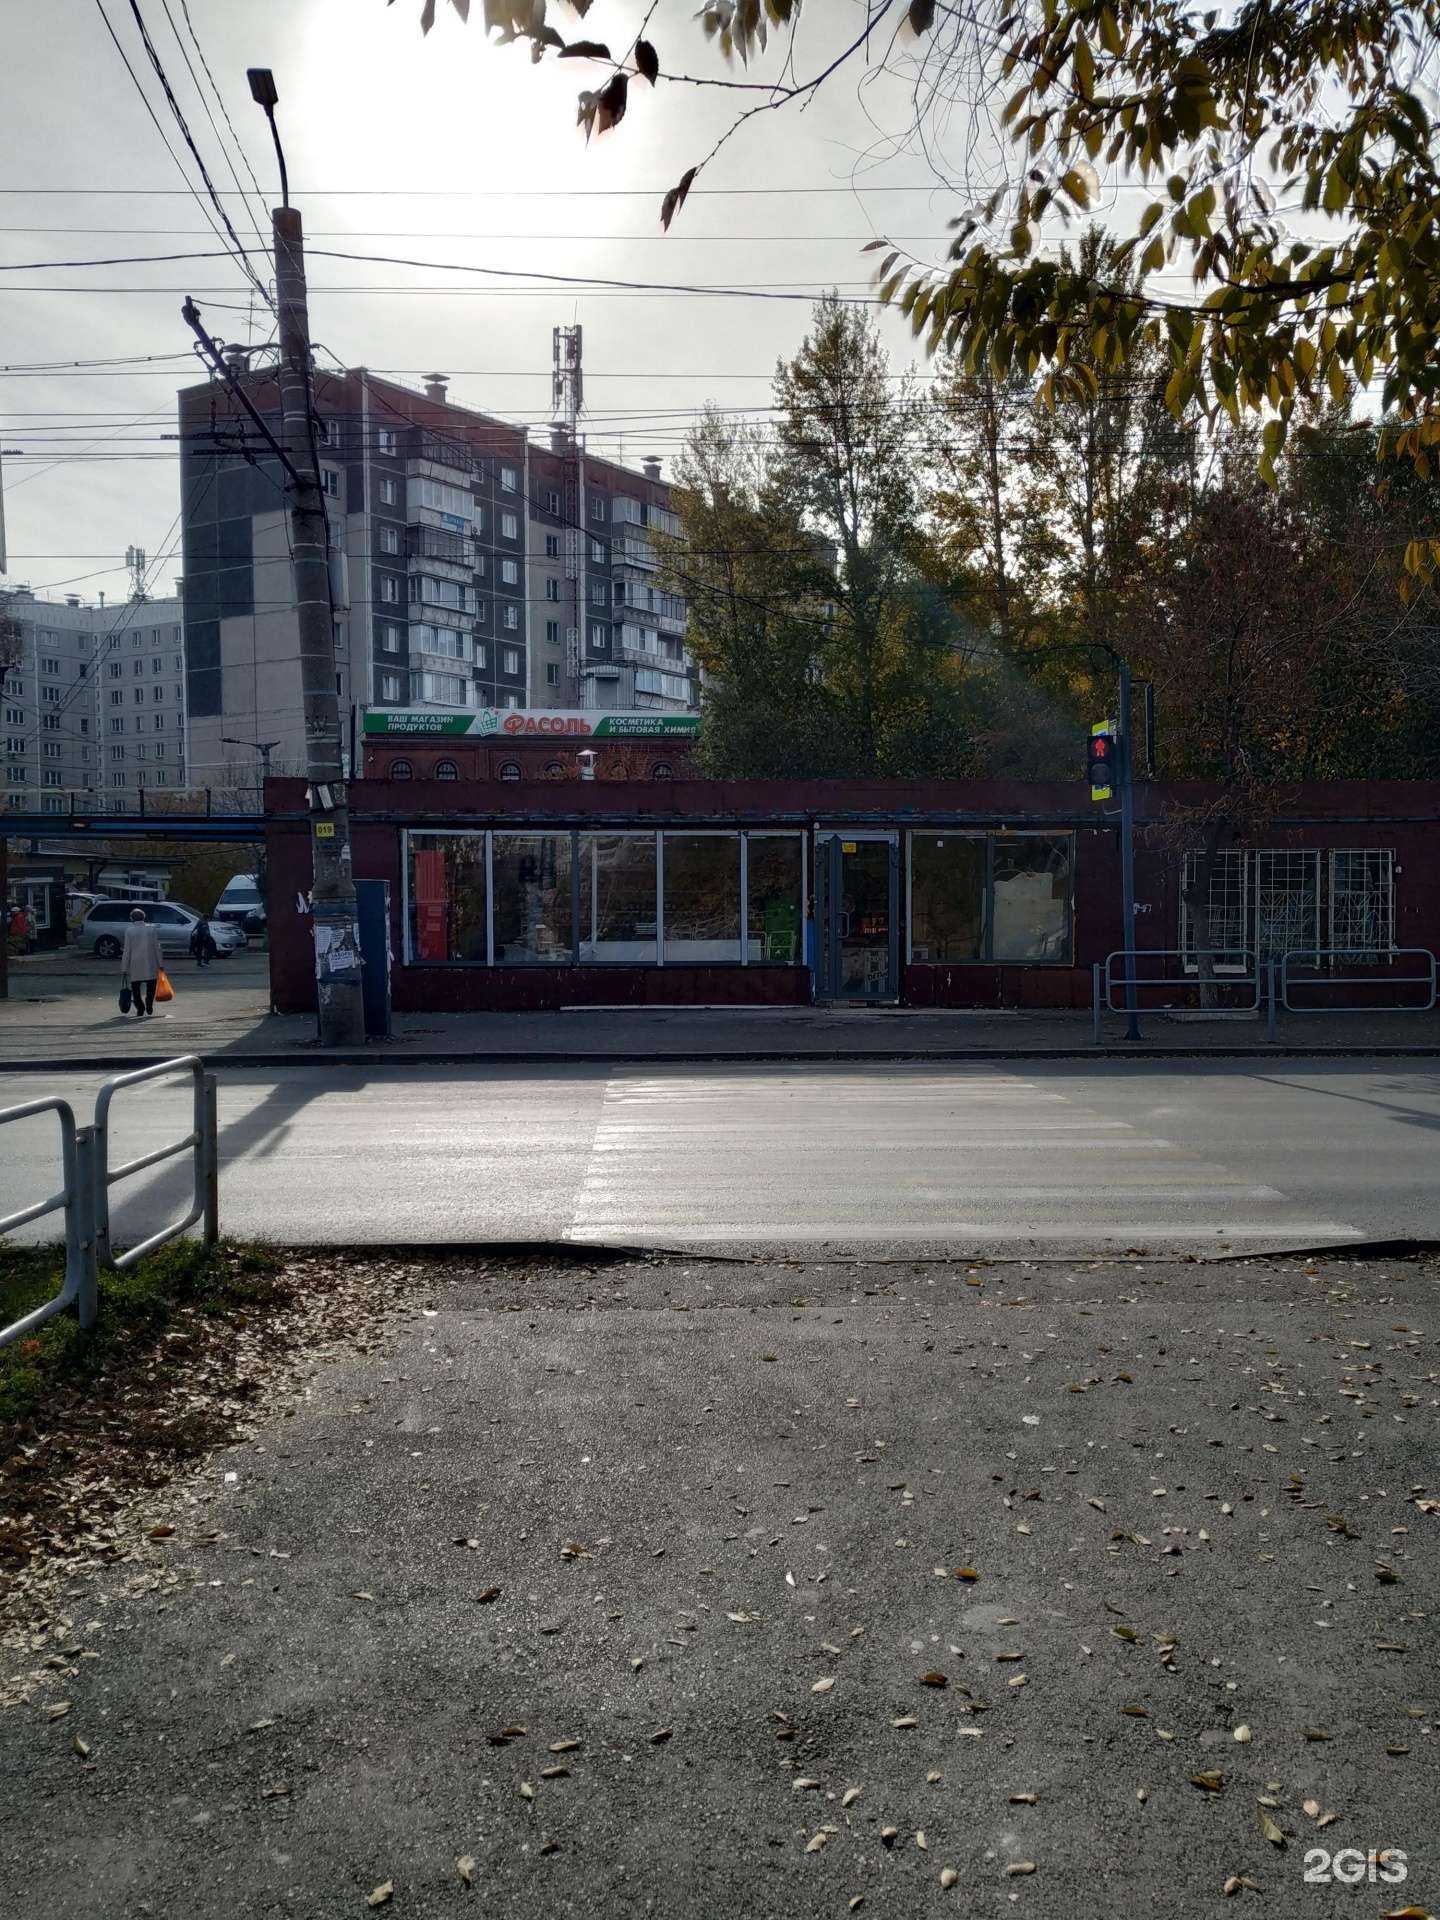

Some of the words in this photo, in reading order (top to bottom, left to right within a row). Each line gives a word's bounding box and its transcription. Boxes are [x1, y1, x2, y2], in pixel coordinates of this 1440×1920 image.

[387, 714, 408, 723] ВАШ
[410, 715, 454, 724] МАГАЗИН
[608, 717, 664, 726] КОСМЕТИКА
[387, 723, 442, 732] ПРОДУКТОВ
[503, 714, 592, 736] ФАСОЛЬ
[608, 725, 616, 733] И
[618, 725, 661, 733] БЫТОВАЯ
[663, 725, 696, 734] ХИМИЯ
